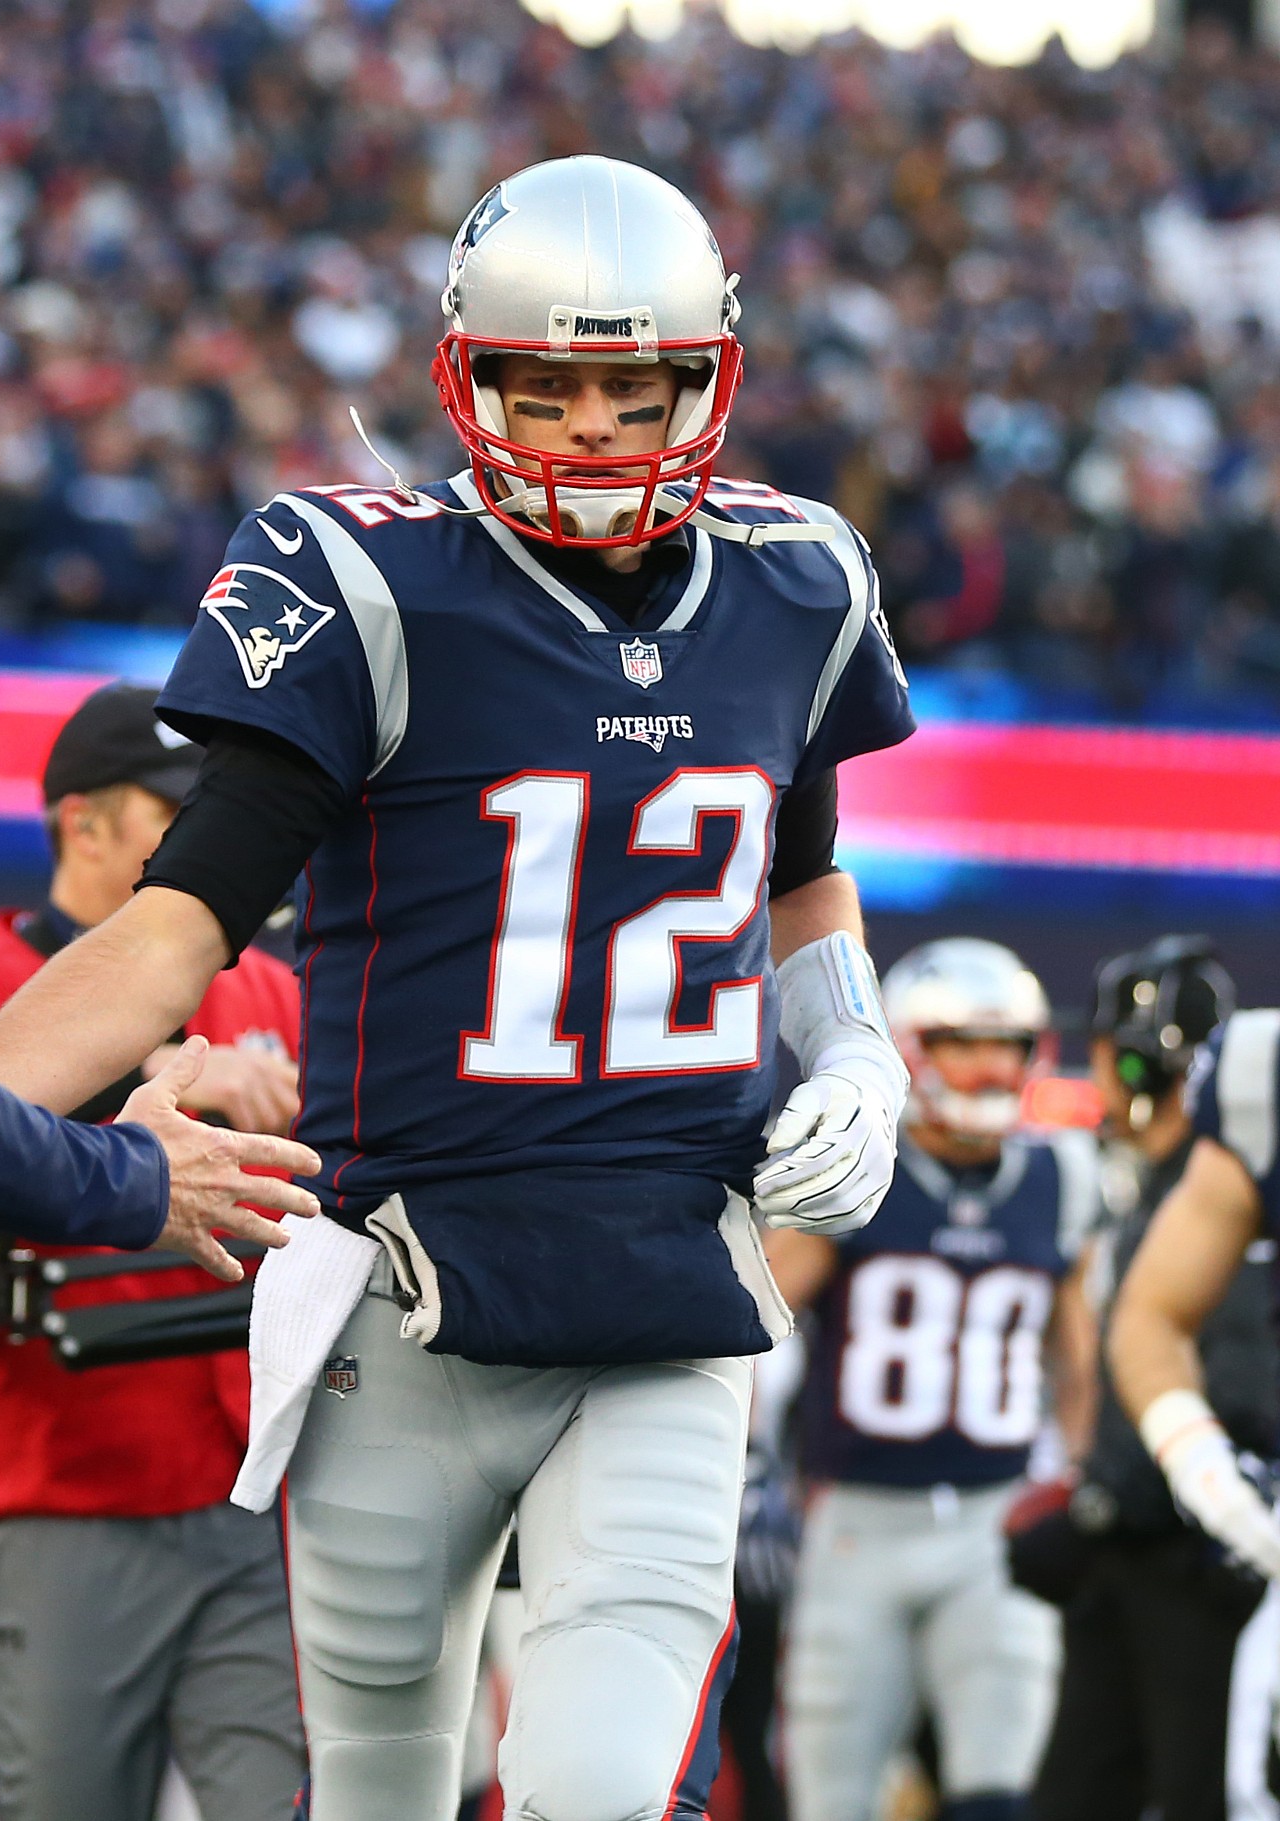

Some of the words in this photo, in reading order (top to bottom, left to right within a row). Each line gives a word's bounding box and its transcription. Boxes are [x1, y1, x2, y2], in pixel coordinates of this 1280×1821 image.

[574, 315, 633, 337] PATRIOTS
[629, 660, 656, 679] NFL
[596, 715, 694, 743] PATRIOTS
[456, 766, 776, 1084] 12
[836, 1252, 1054, 1448] 80
[328, 1371, 356, 1390] NFL
